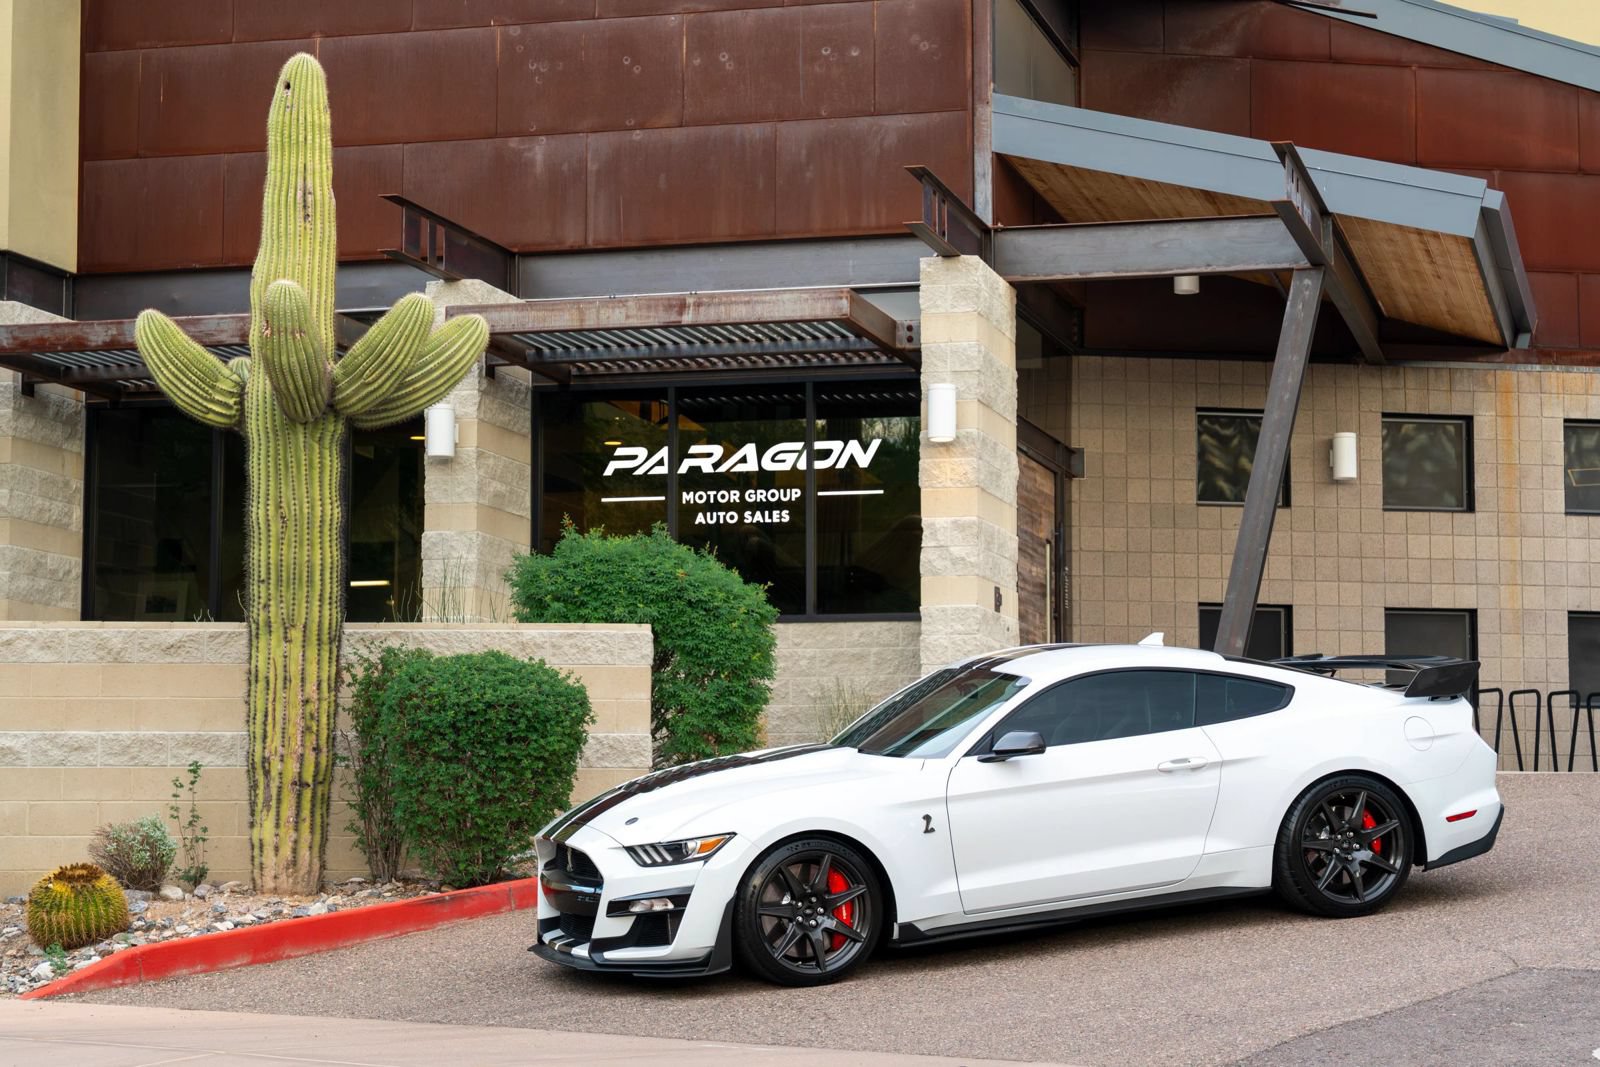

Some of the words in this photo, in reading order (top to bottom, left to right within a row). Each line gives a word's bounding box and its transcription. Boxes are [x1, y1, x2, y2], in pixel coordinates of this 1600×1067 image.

[602, 437, 883, 477] PARAGON
[682, 490, 741, 505] MOTOR
[744, 488, 802, 503] GROUP
[694, 510, 739, 525] AUTO
[743, 509, 790, 524] SALES
